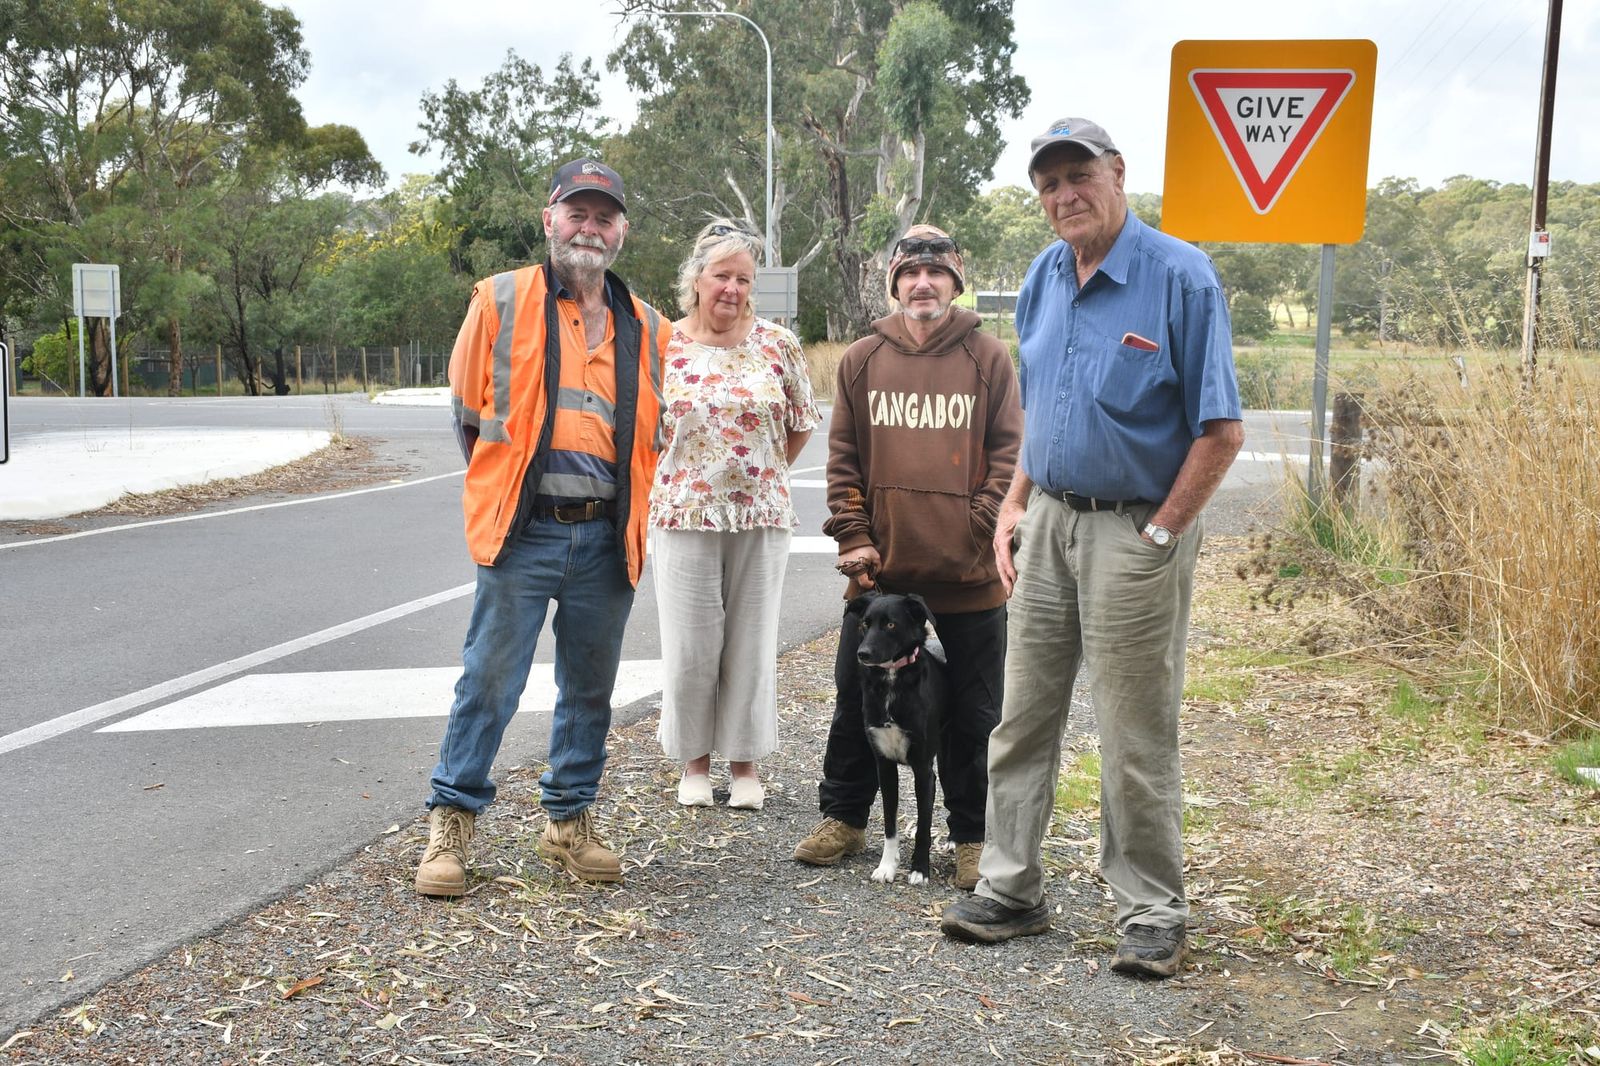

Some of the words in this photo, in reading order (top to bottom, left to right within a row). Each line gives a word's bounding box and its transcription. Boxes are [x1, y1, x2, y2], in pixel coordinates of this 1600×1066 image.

[1236, 96, 1304, 119] GIVE
[1245, 125, 1293, 143] WAY
[867, 390, 977, 430] KANGABOY
